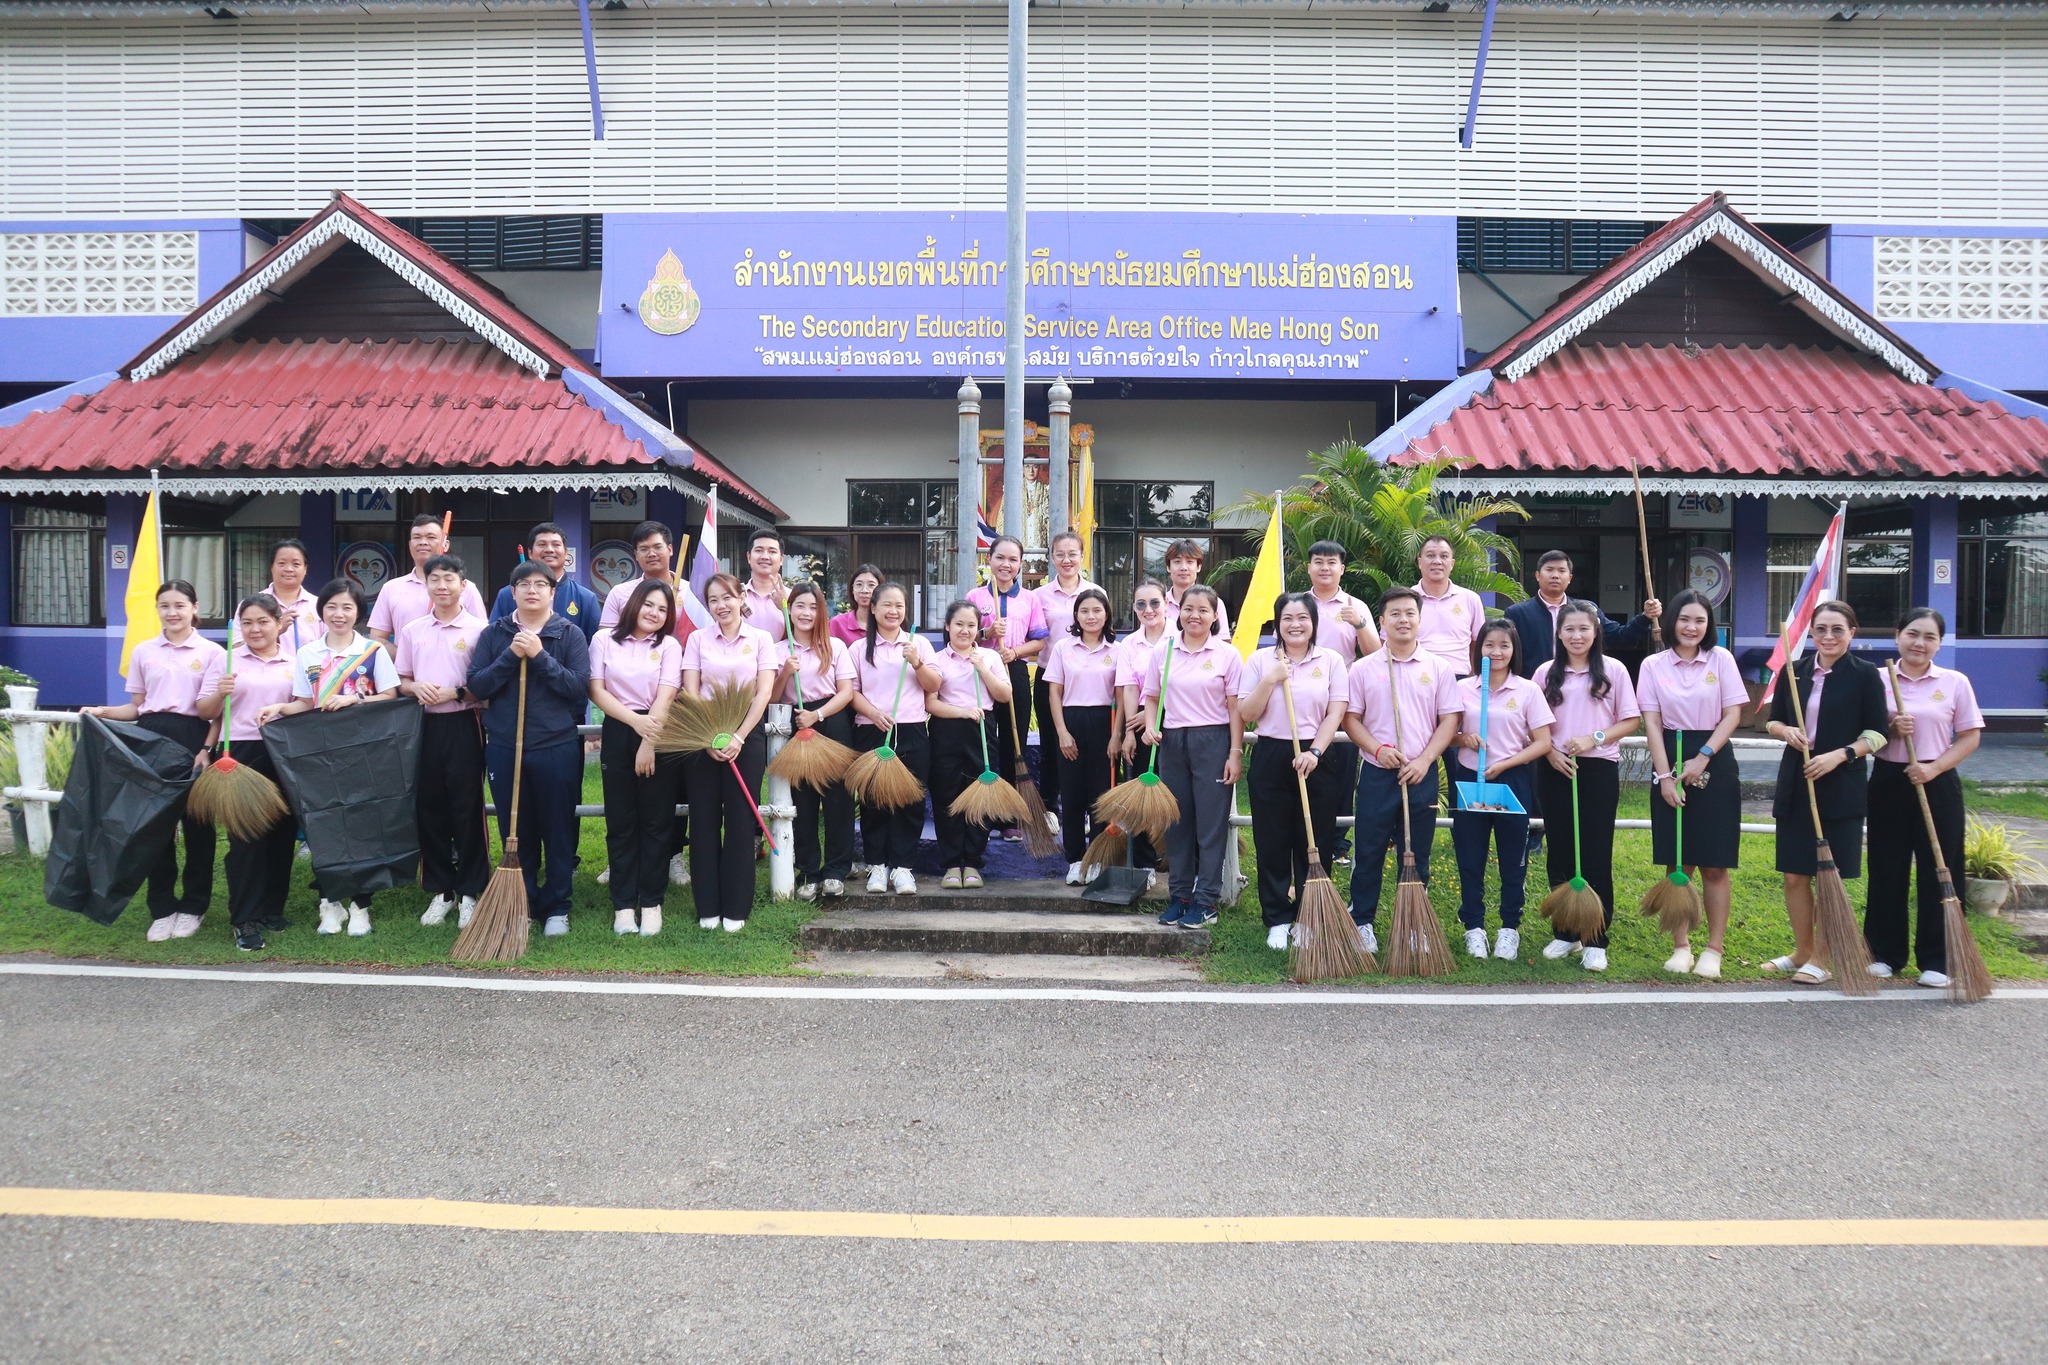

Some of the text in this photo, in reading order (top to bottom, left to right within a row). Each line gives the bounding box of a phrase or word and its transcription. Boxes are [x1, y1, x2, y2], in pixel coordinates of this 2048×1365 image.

[759, 313, 1379, 346] The Secondary Educatio Service Area Office Mae Hong Son
[931, 345, 1070, 366] องค์กรทสมัย
[1077, 345, 1200, 367] บริการด้วยใจ
